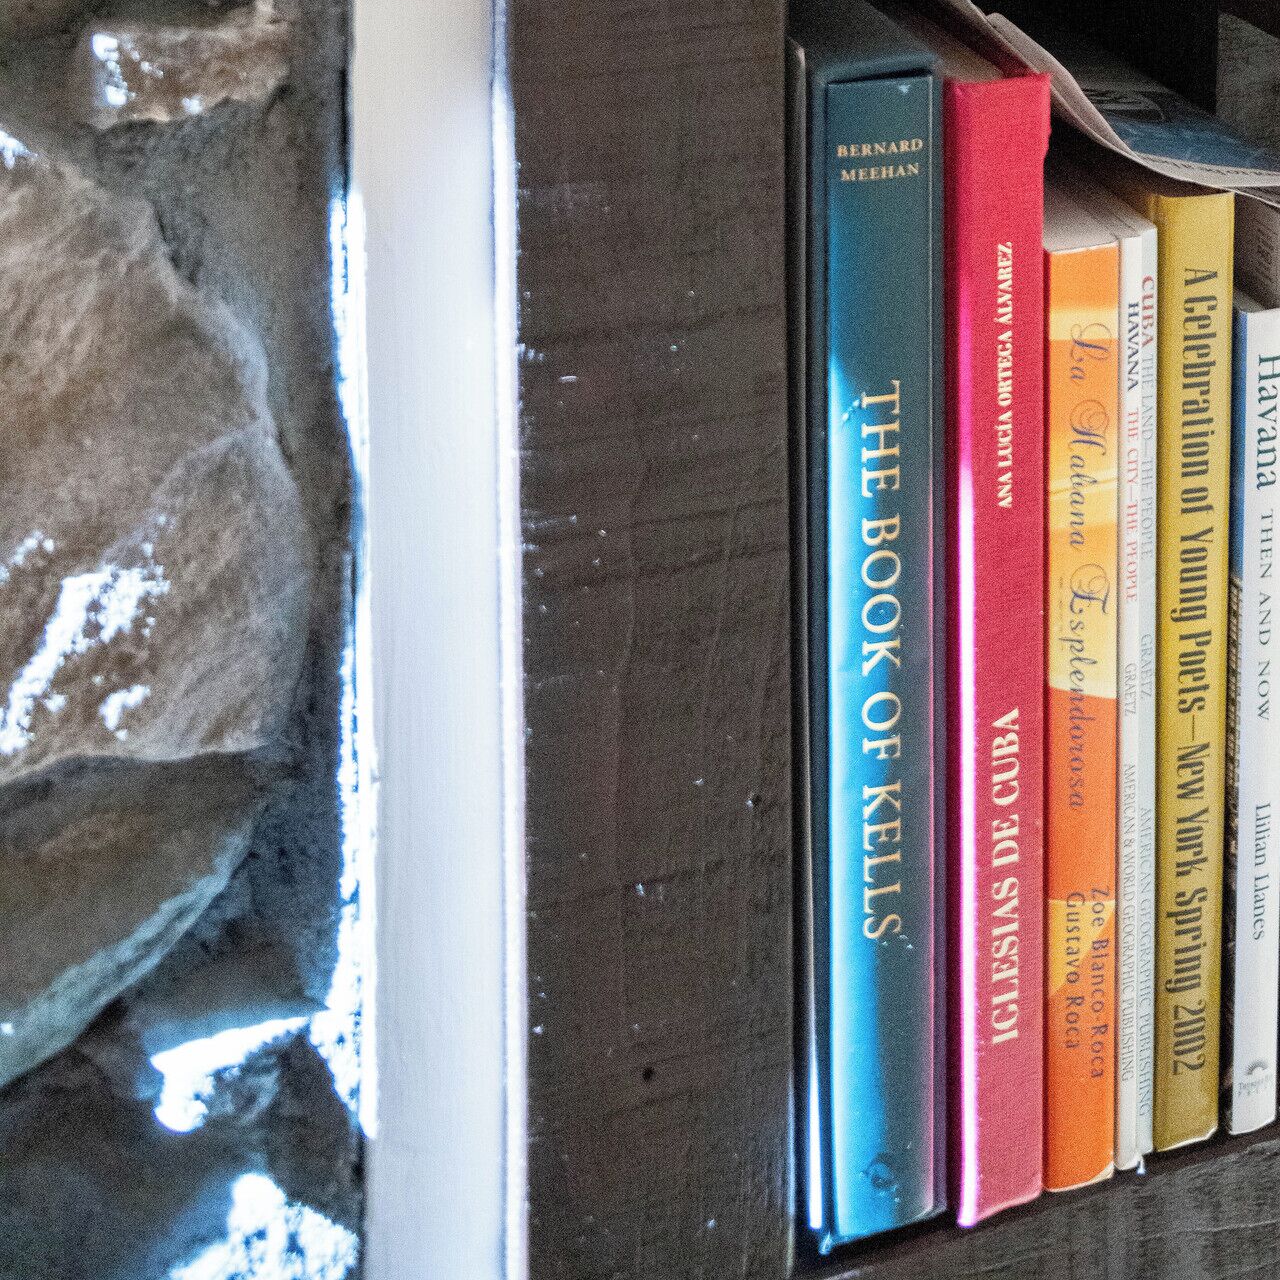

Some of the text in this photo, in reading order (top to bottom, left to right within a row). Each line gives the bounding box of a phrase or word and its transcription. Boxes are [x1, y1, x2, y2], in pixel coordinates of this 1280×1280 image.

[837, 138, 924, 157] BERNARD
[841, 162, 919, 182] MEEHAN
[1141, 275, 1154, 347] CUBA
[1184, 267, 1218, 287] A
[993, 241, 1013, 508] ANA LUCÍA ORTEGA ÁLVAREZ
[1127, 302, 1139, 392] HAVANA
[1141, 354, 1153, 389] THE
[1181, 294, 1217, 478] Celebration
[1128, 408, 1138, 441] THE
[1141, 497, 1153, 560] PEOPLE
[1180, 486, 1214, 516] of
[1058, 323, 1112, 807] La Habana Esplendorosa
[1126, 537, 1137, 601] PEOPLE
[1170, 527, 1214, 623] Young
[1257, 505, 1274, 578] THEN
[1257, 589, 1272, 647] AND
[860, 379, 902, 940] THE BOOK OF KELLS
[1125, 662, 1137, 717] GRAETZ
[1140, 633, 1152, 698] GRAETZ
[1256, 660, 1270, 721] NOW
[992, 709, 1020, 1045] IGLESIAS DE CUBA
[1175, 806, 1209, 878] York
[1252, 802, 1271, 940] Llilian Llanes
[1121, 763, 1135, 1082] AMERICAN & WORLD GEOGRAPHIC PUBLISHING
[1165, 885, 1208, 995] Spring
[1066, 891, 1085, 1049] Gustavo Roca
[1091, 885, 1110, 1078] Zoe Blanco-Roca
[1139, 807, 1151, 1116] AMERICAN GEOGRAPHIC PUBLISHING
[1173, 1001, 1203, 1077] 2002
